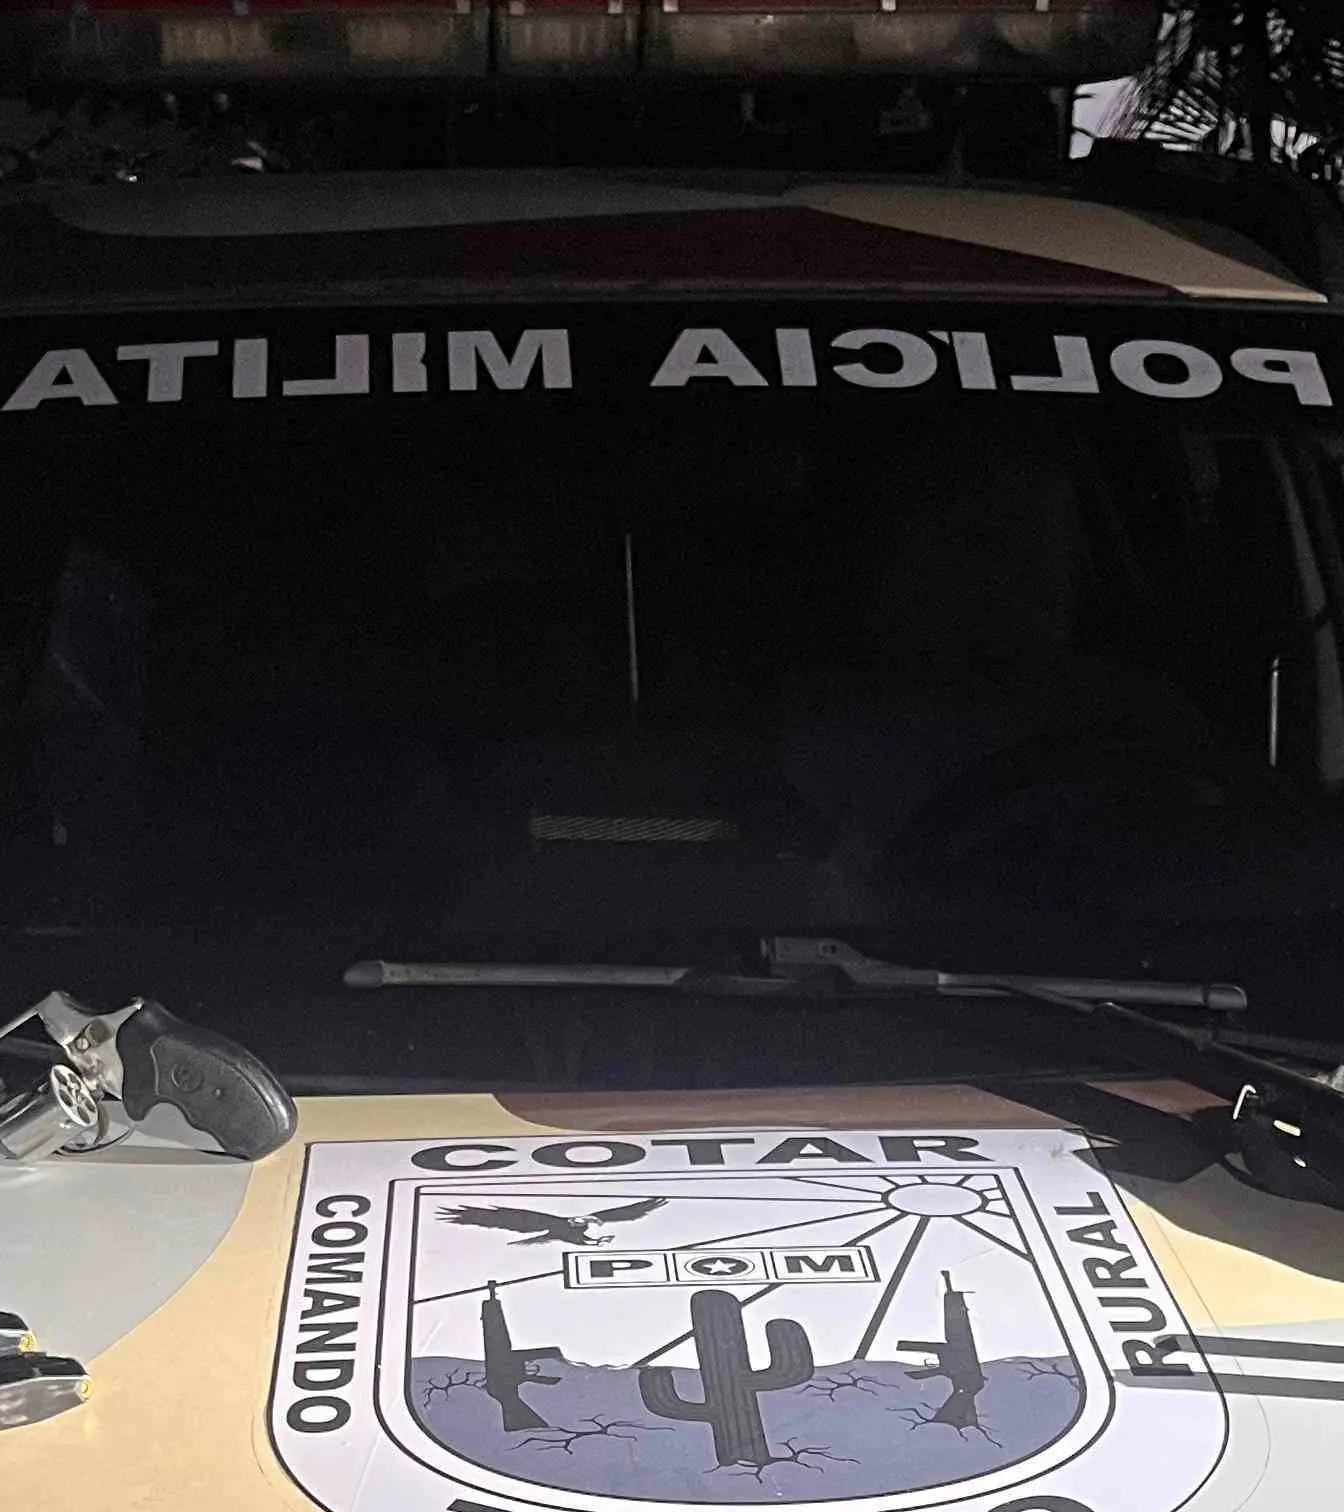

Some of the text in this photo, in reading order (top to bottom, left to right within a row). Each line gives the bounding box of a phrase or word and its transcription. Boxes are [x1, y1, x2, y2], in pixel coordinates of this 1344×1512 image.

[409, 1136, 997, 1172] COTAR
[286, 1194, 372, 1434] COMANDO
[588, 1254, 856, 1279] P M
[1053, 1191, 1196, 1377] RURAL
